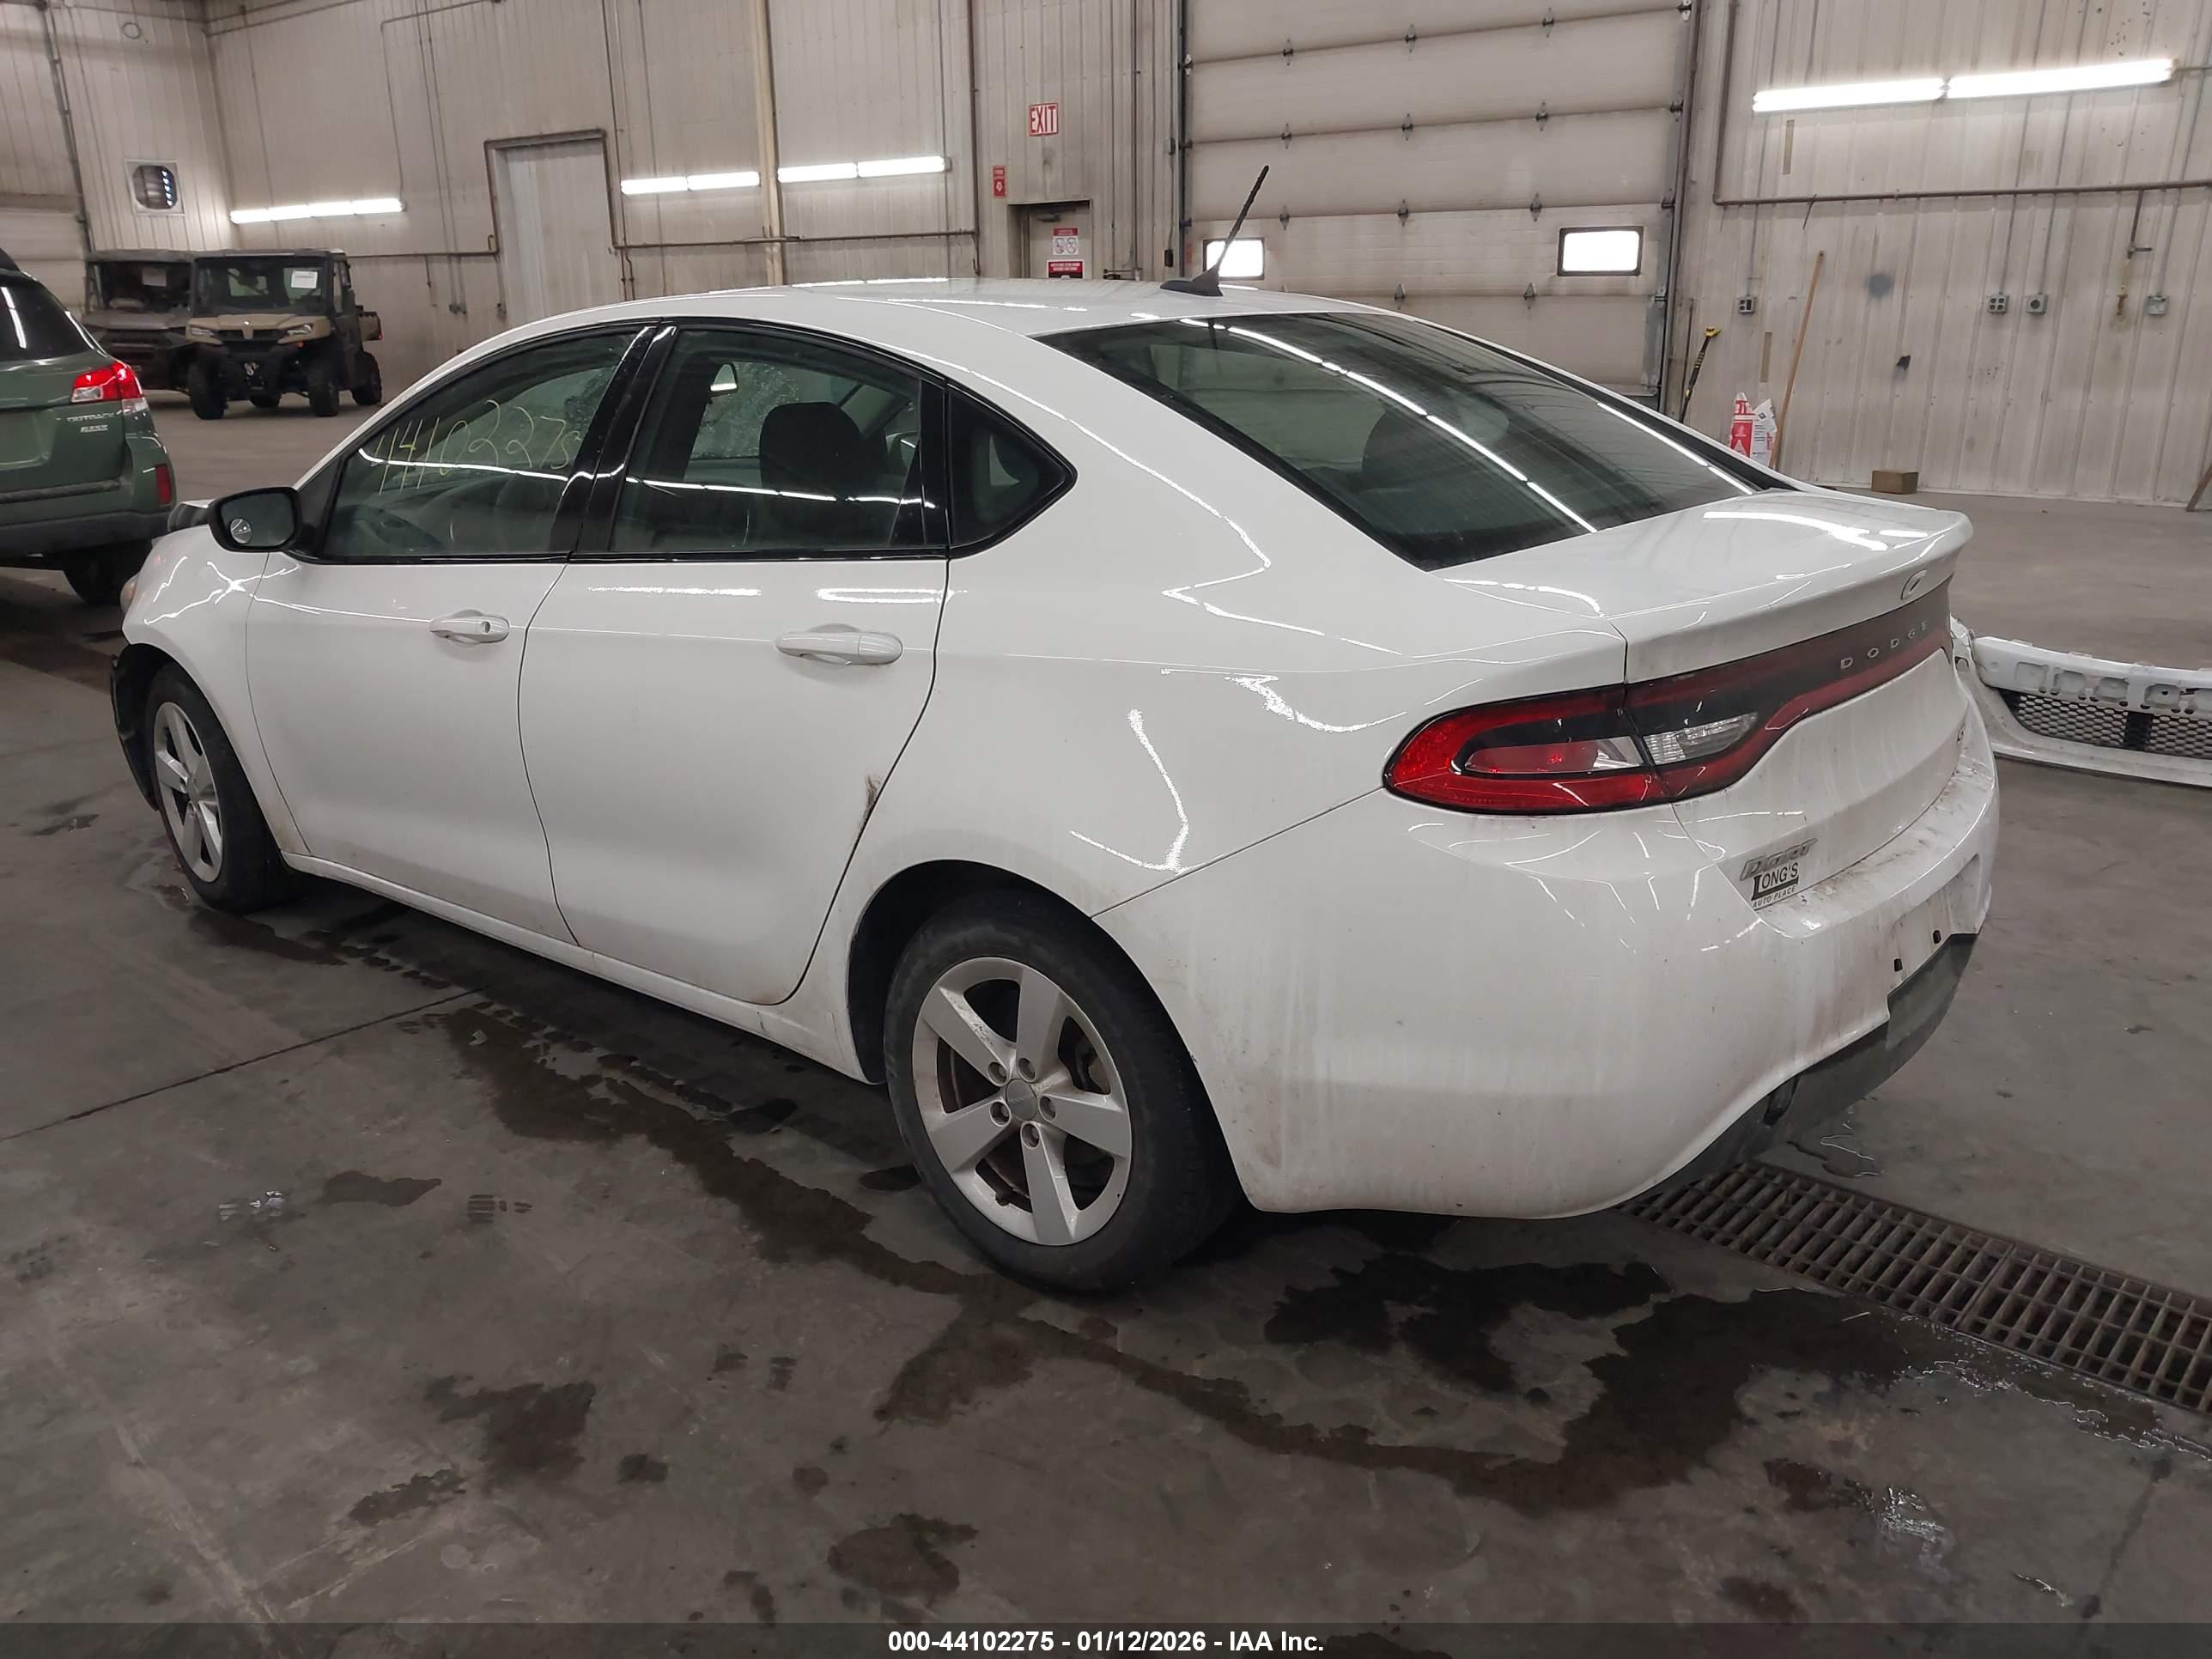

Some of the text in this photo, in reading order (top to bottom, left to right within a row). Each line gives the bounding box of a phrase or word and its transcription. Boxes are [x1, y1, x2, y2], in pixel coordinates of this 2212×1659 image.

[1030, 106, 1056, 134] EXIT
[1840, 620, 1929, 670] DODGE
[1751, 861, 1799, 901] LONG'S
[1753, 885, 1796, 908] AUTO PLACE
